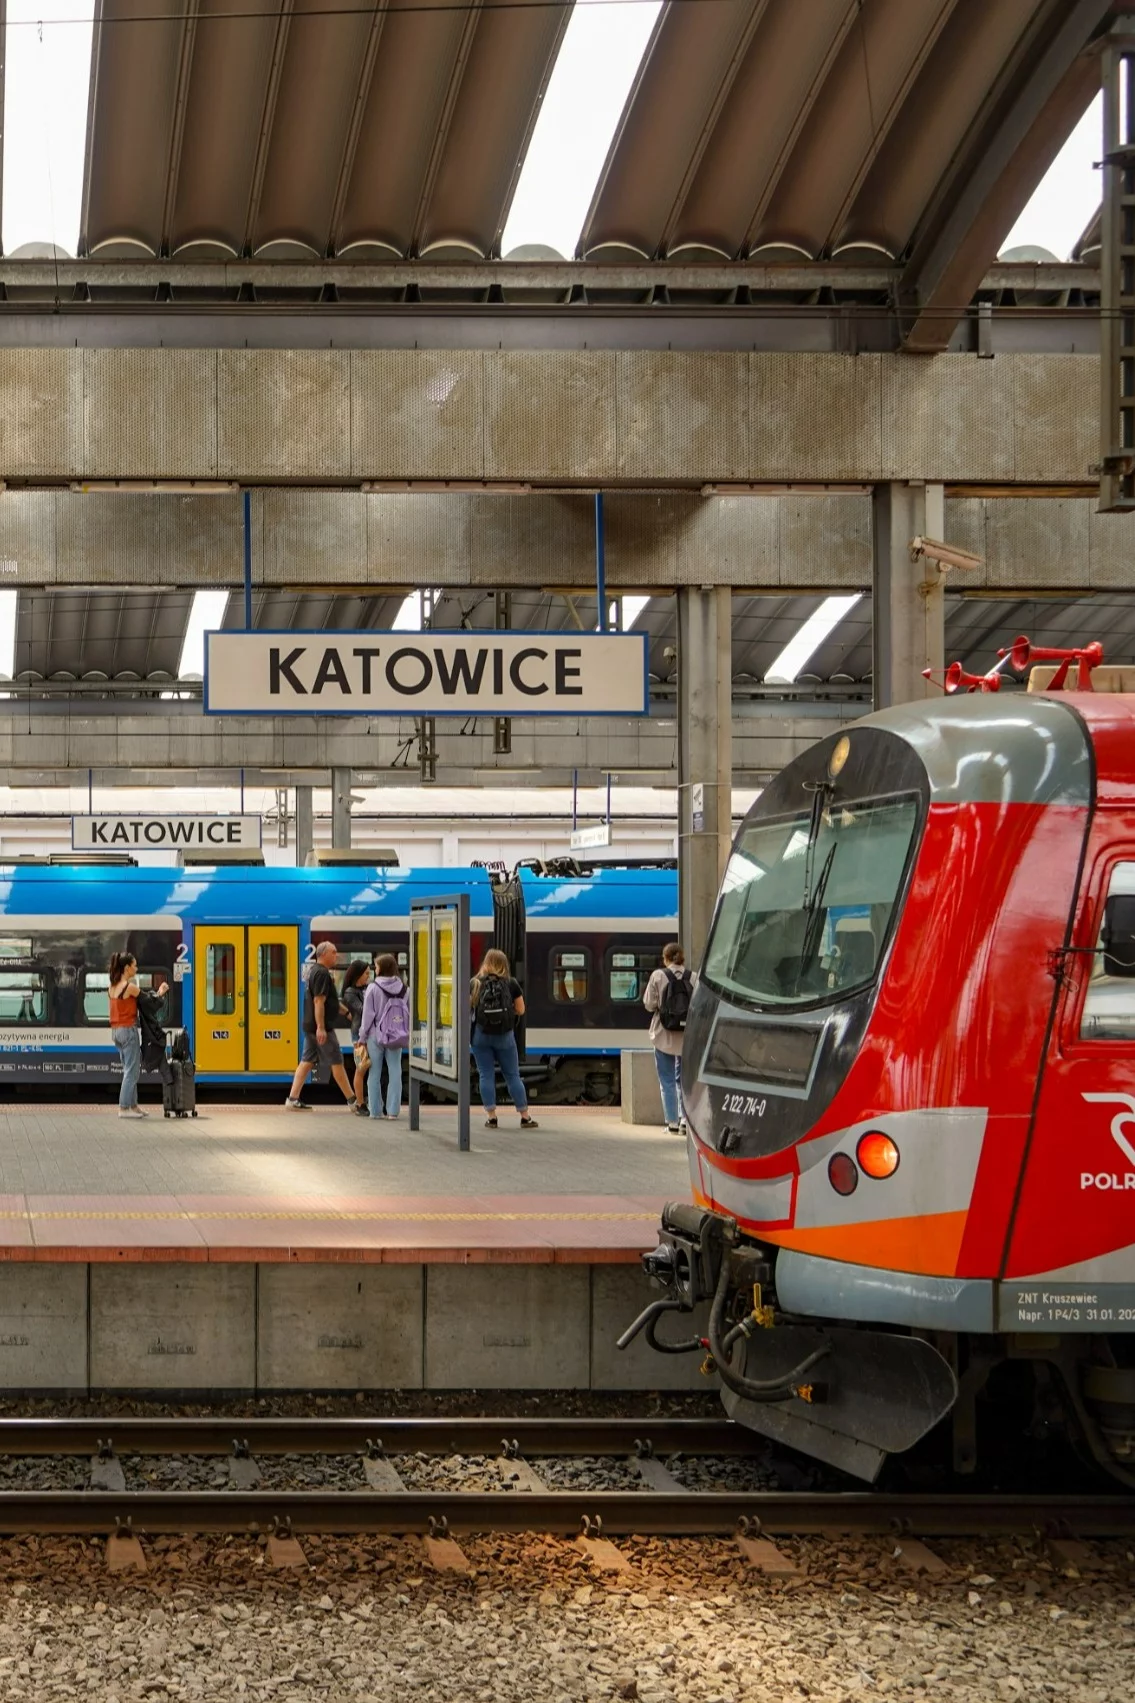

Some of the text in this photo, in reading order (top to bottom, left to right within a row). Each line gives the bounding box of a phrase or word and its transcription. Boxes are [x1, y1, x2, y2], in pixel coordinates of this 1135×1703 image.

[269, 647, 583, 695] KATOWICE
[91, 821, 242, 843] KATOWICE
[176, 943, 189, 963] 2
[304, 943, 317, 963] 2
[38, 1032, 70, 1042] energia
[722, 1094, 767, 1117] 2 122 714-0
[1017, 1292, 1098, 1304] ZNT Kruszewiec
[1018, 1309, 1044, 1322] Napr.
